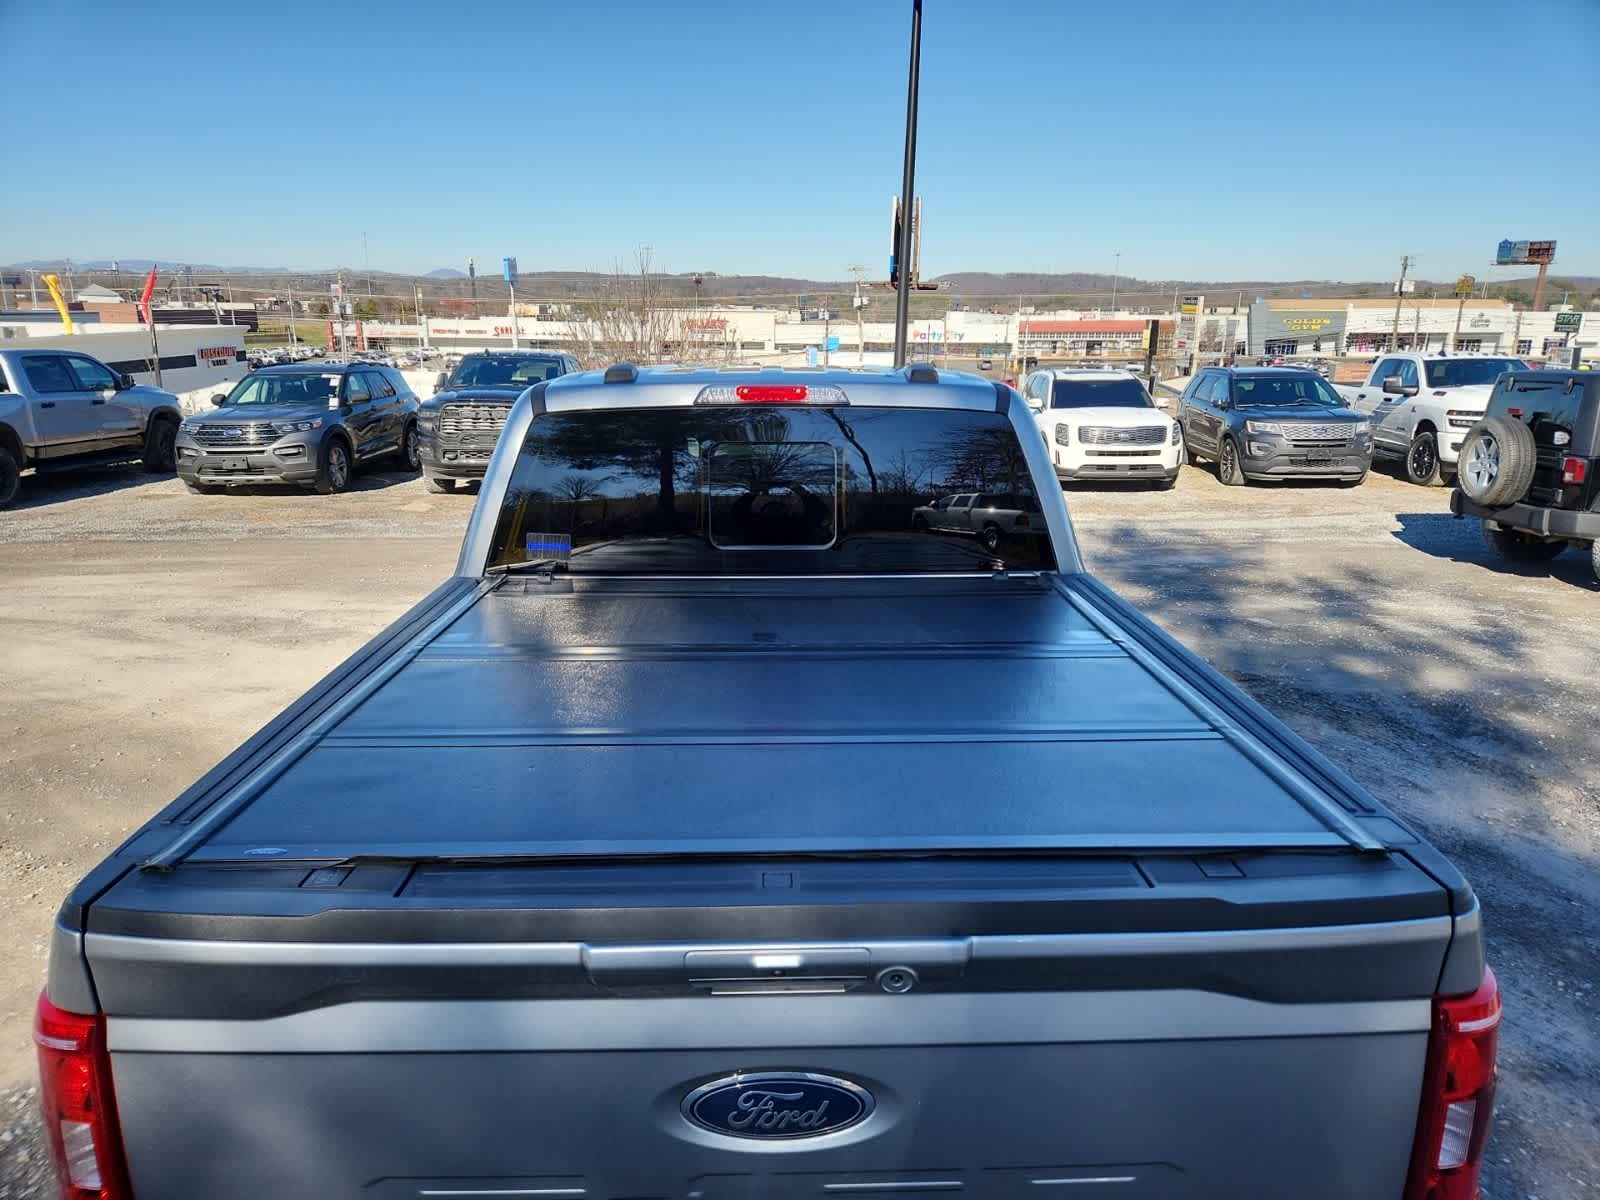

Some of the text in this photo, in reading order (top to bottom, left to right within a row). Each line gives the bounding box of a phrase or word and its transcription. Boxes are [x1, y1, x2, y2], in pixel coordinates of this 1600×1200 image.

[1558, 314, 1580, 323] STAR
[913, 329, 943, 340] Paty
[728, 1090, 829, 1129] Ford
